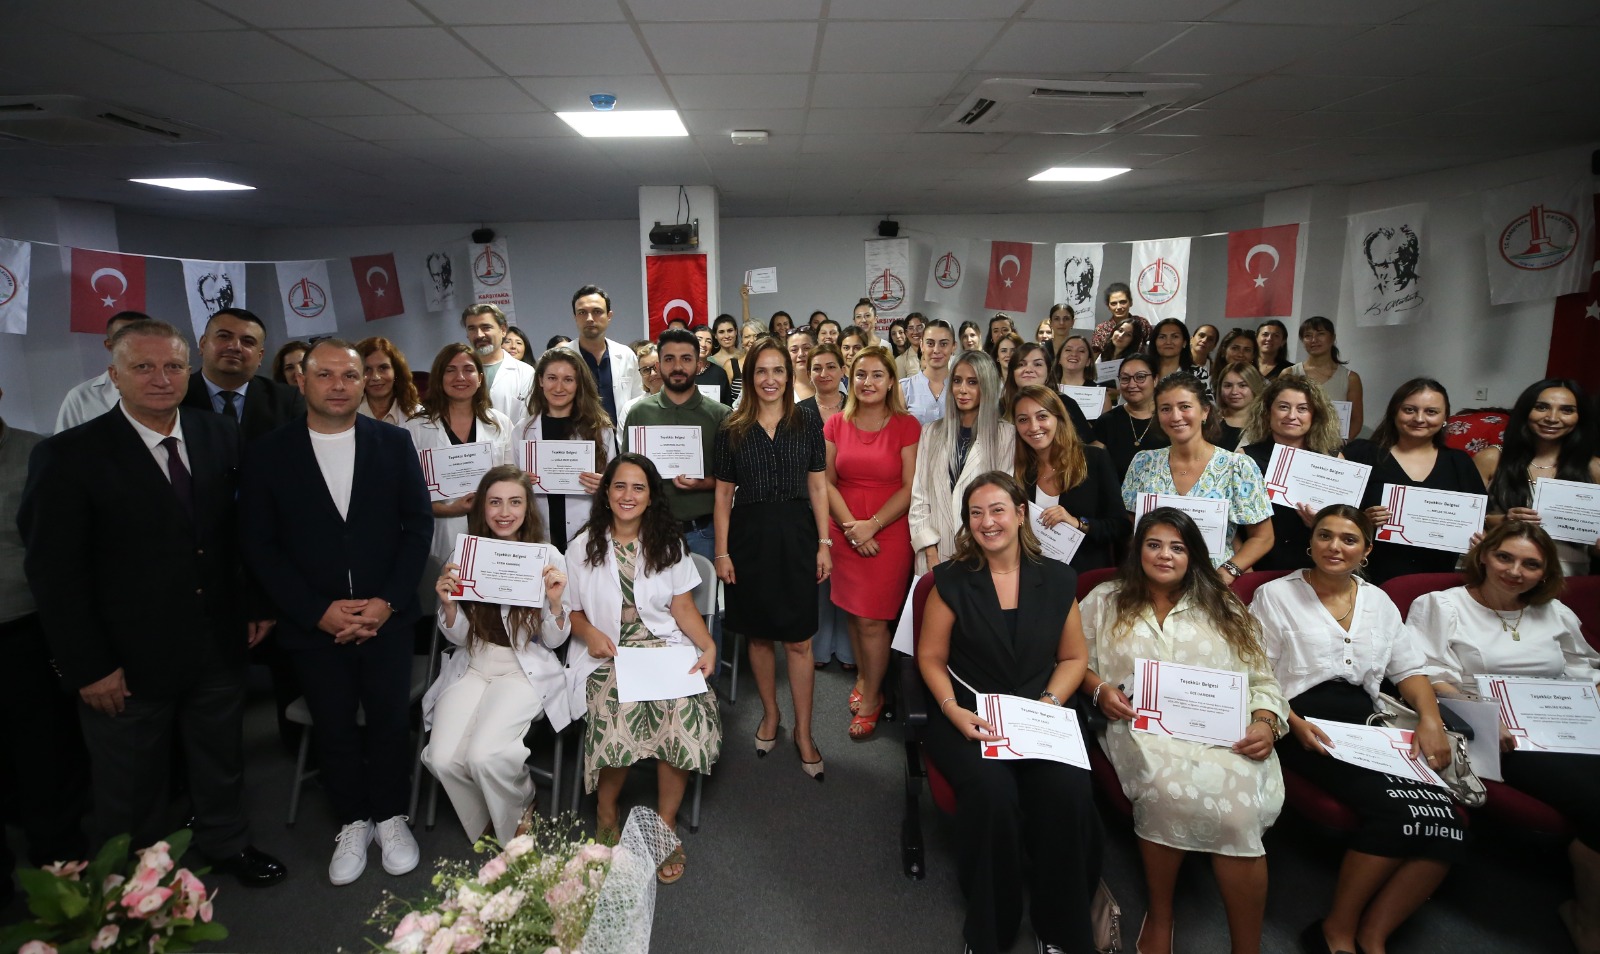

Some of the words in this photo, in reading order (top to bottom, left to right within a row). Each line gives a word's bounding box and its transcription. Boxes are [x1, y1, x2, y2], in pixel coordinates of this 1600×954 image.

[478, 292, 509, 300] KARŞIYAKA
[1180, 678, 1201, 686] Teşekkür
[1201, 681, 1219, 689] Belgesi
[1386, 788, 1453, 804] another
[1408, 804, 1454, 820] point
[1403, 822, 1421, 836] of
[1425, 823, 1463, 841] view
